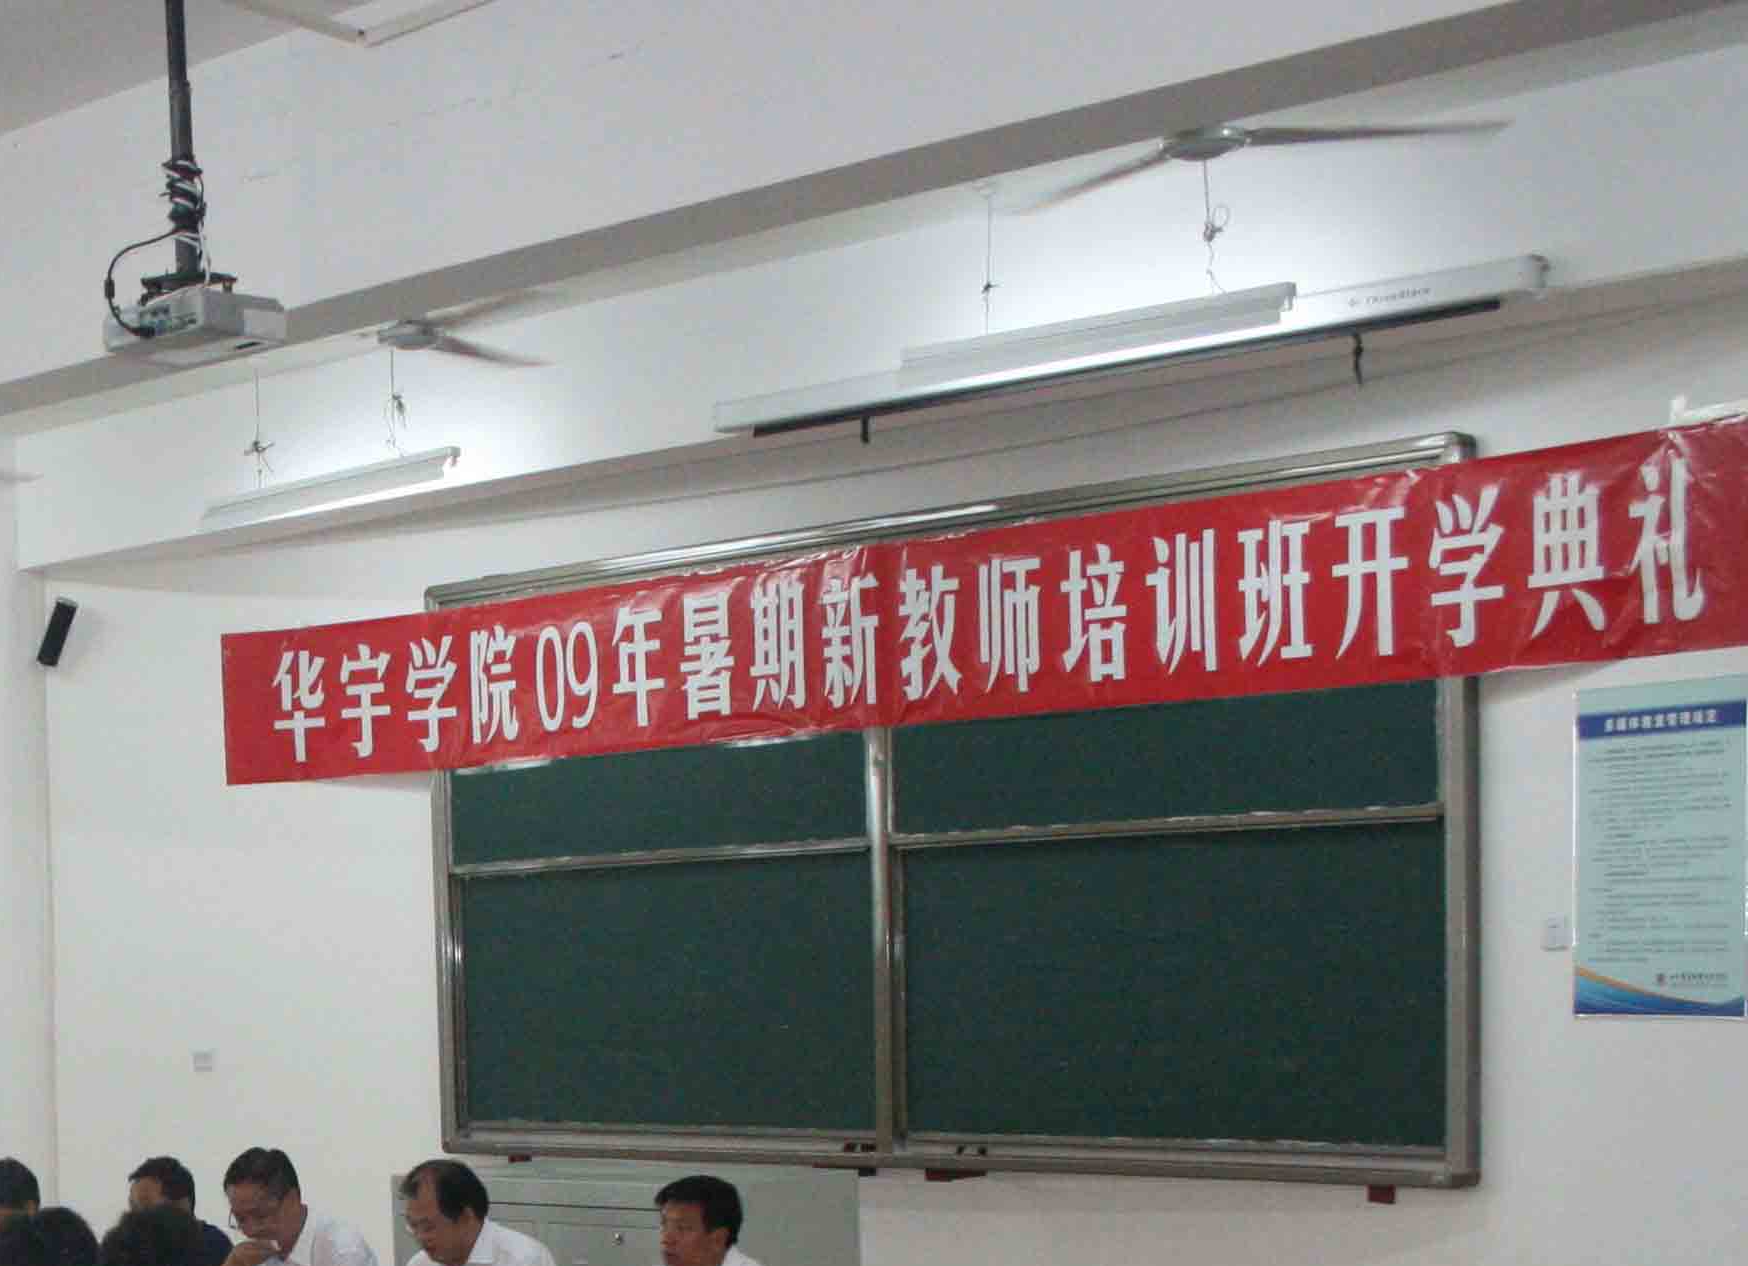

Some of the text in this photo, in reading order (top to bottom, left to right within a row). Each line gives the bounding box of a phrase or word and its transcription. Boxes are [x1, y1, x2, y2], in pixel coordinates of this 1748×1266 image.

[272, 458, 1705, 763] 华宇学院09年暑期新教师培训班开学典礼
